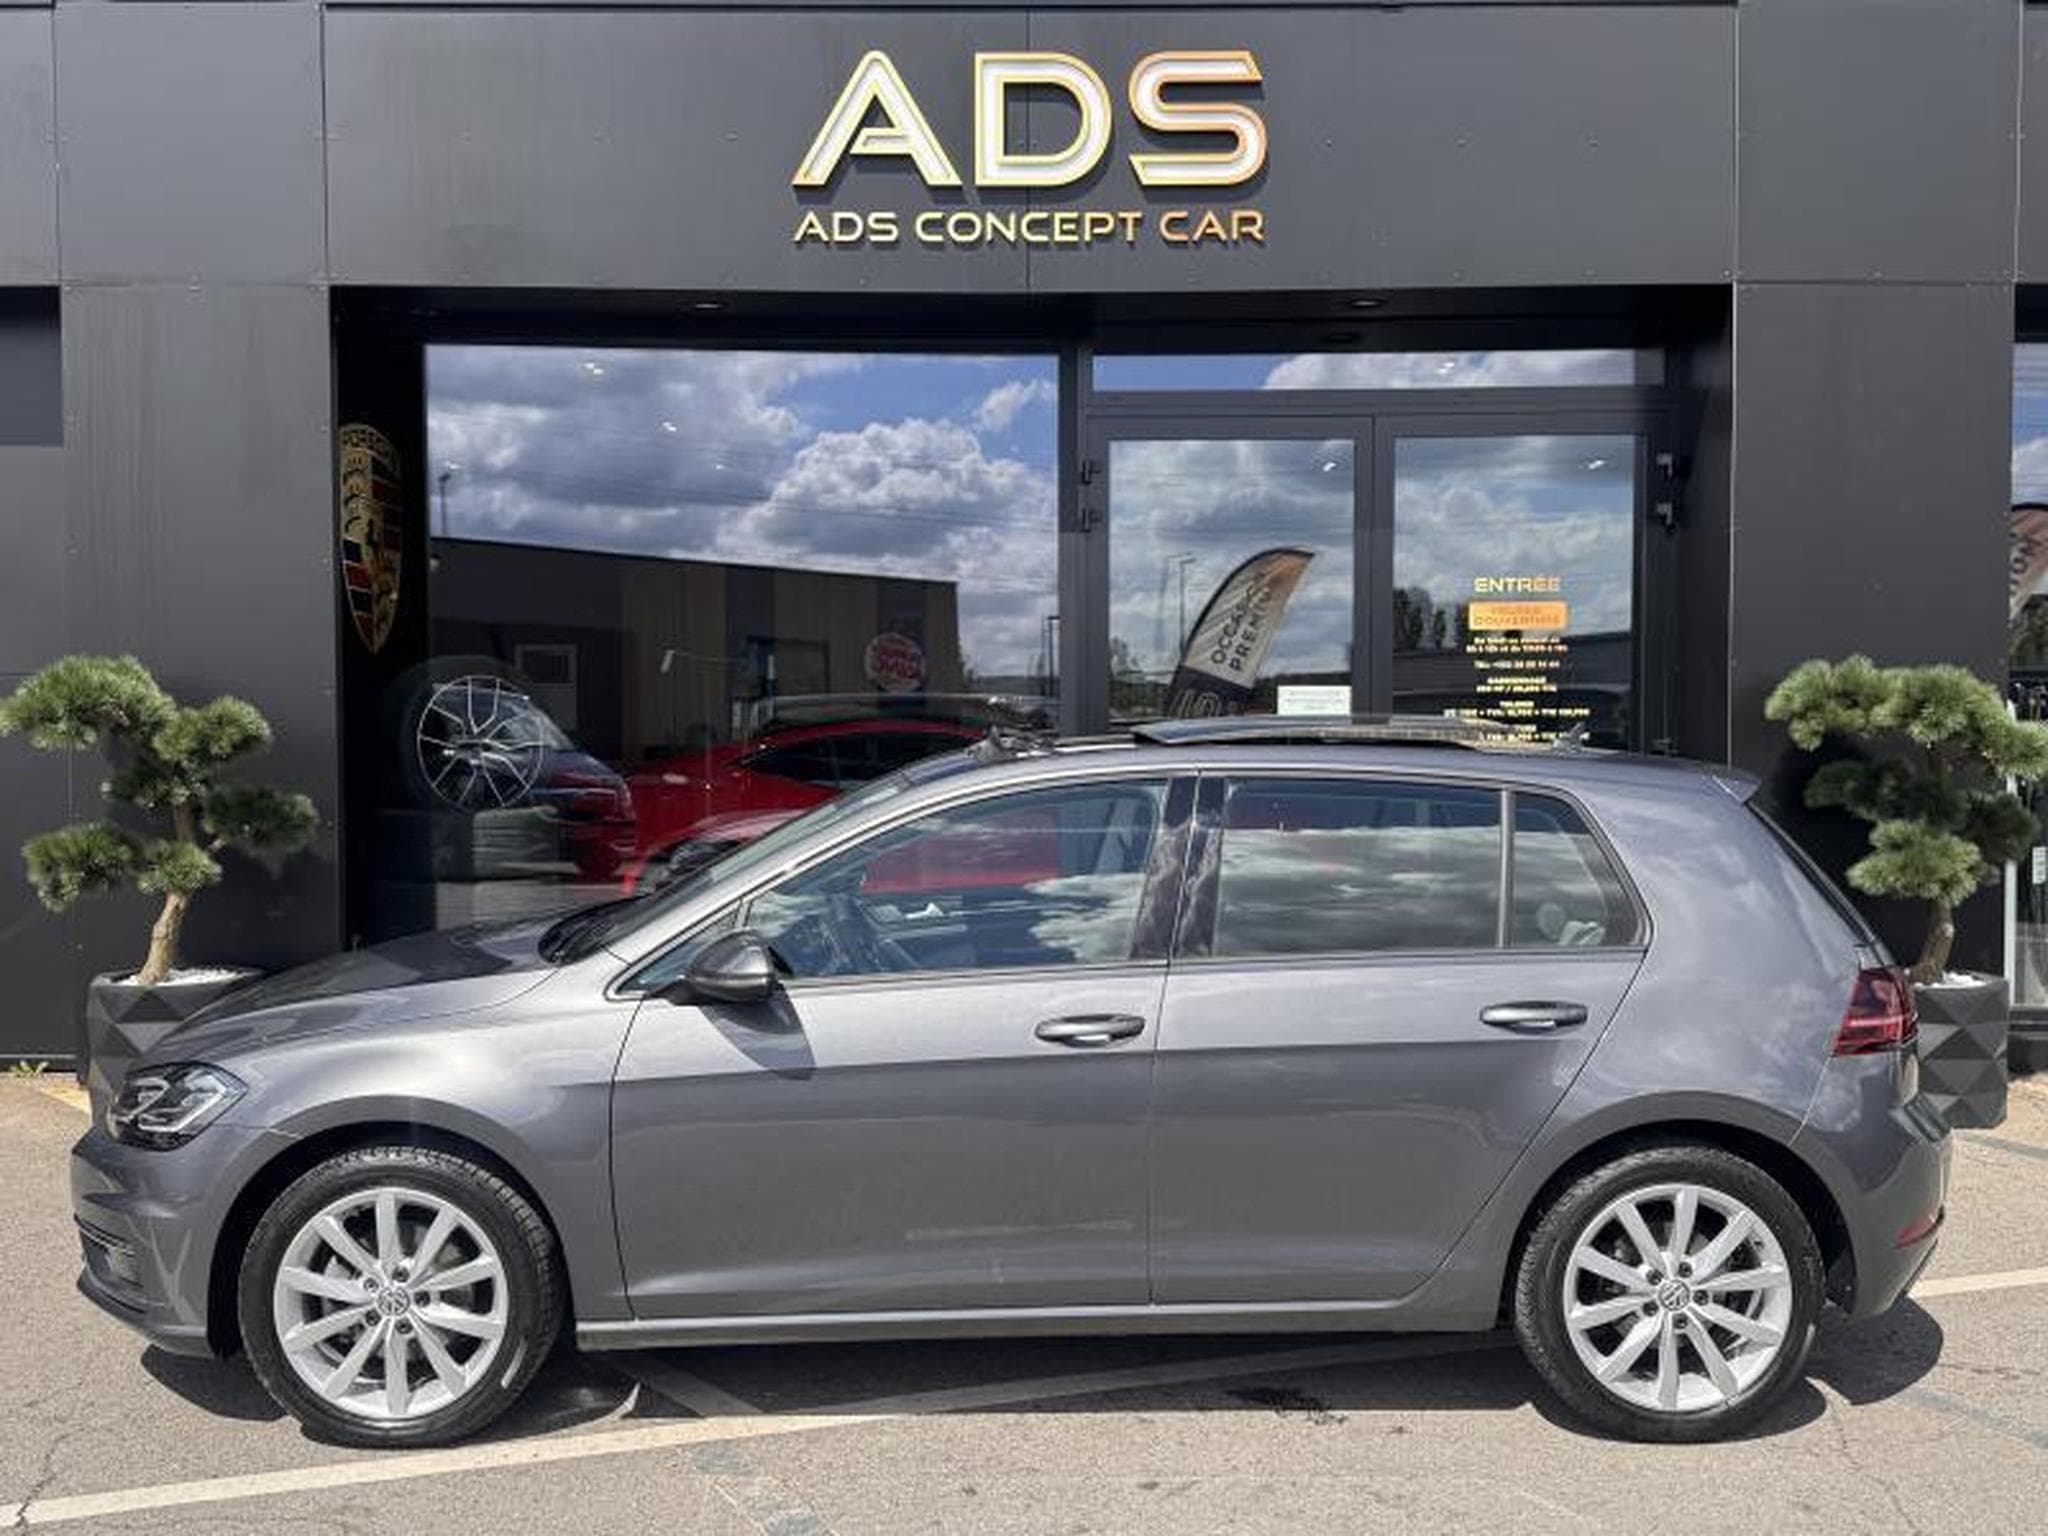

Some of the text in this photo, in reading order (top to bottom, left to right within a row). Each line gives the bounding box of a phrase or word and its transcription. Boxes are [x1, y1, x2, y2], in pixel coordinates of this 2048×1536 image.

[792, 50, 1268, 187] ADS
[793, 210, 1265, 243] ADS CONCEPT CAR
